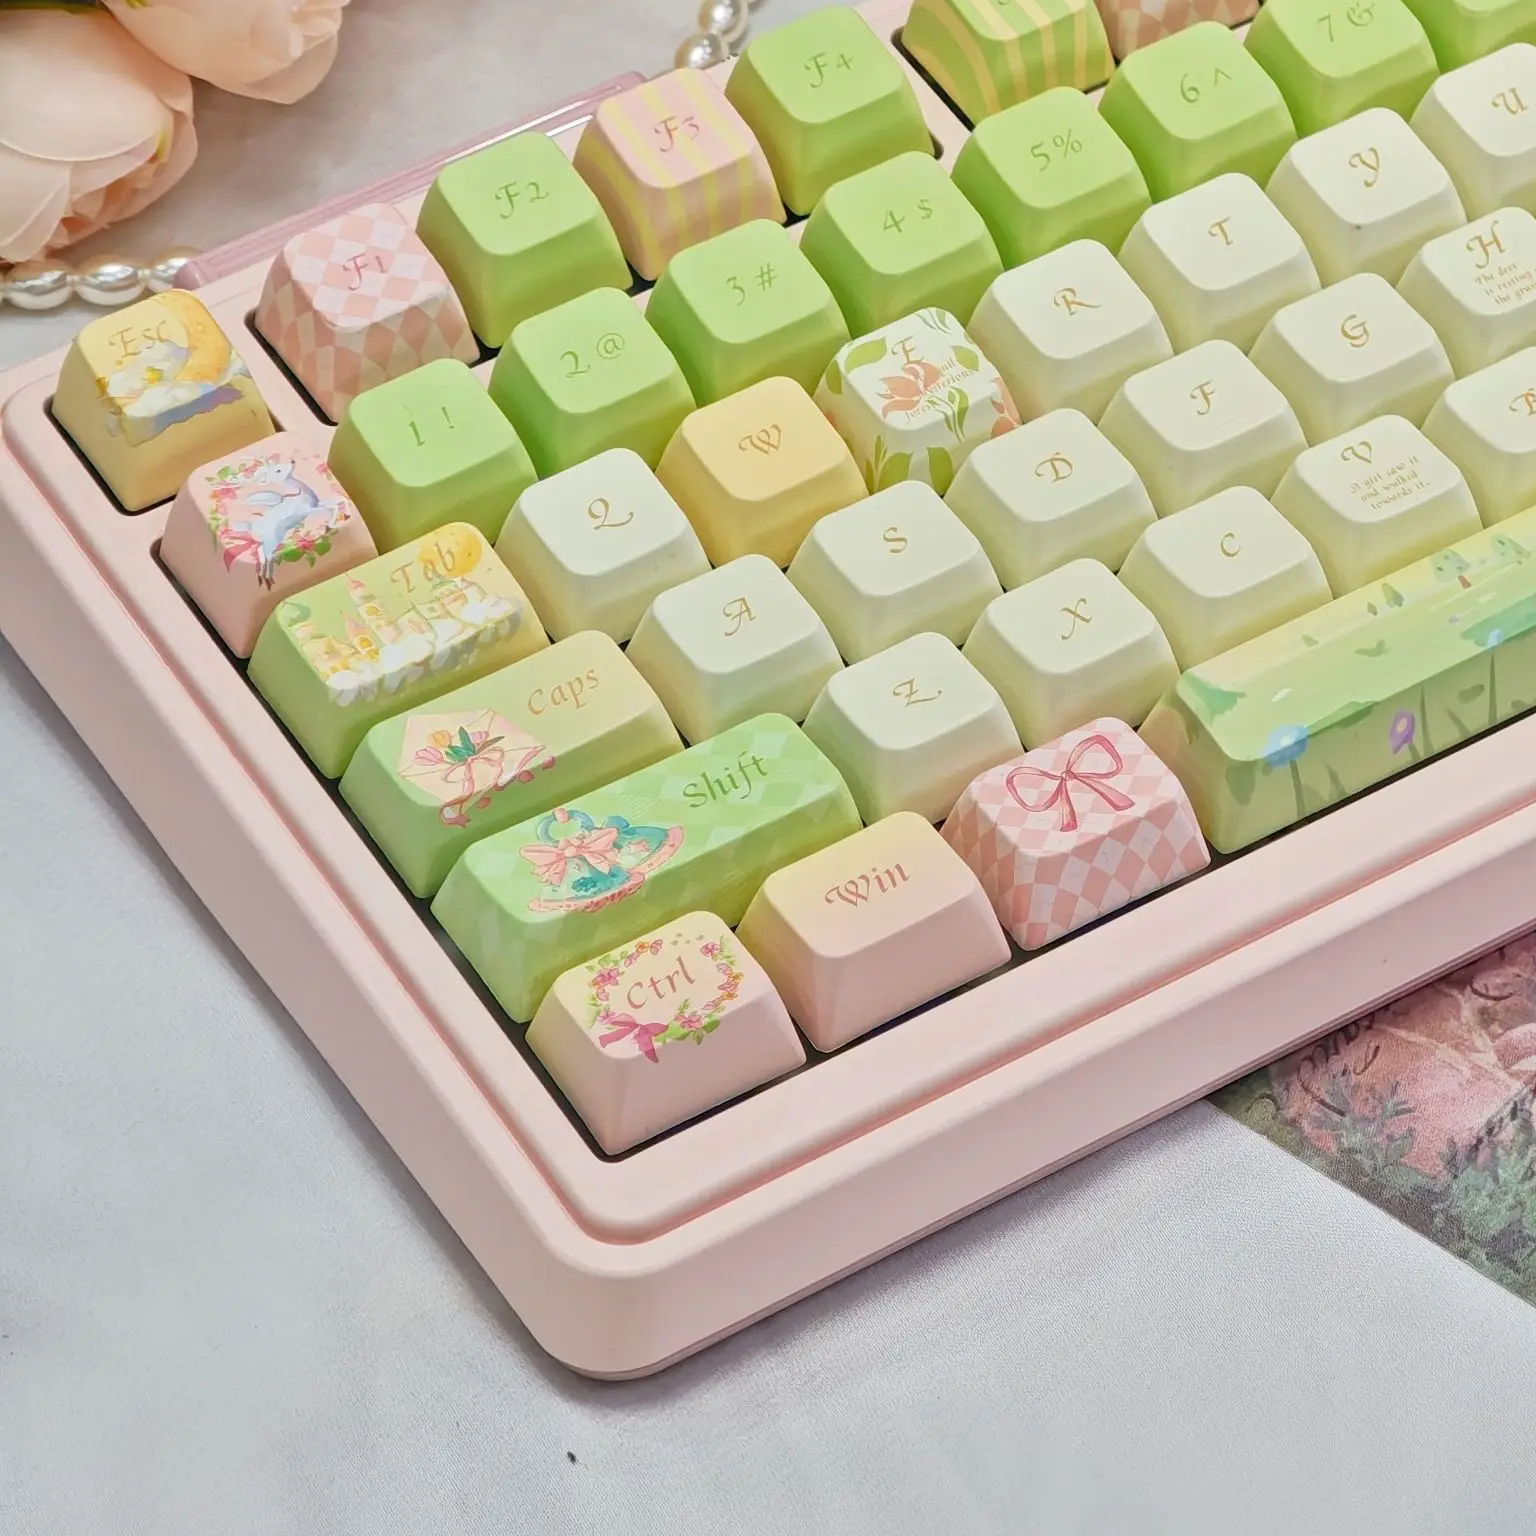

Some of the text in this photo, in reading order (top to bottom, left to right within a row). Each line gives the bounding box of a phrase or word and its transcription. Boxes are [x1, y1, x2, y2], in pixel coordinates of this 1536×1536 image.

[803, 52, 853, 89] F4
[1490, 86, 1529, 116] U
[654, 115, 701, 152] F3
[494, 180, 550, 220] F2
[1464, 218, 1508, 271] H
[343, 254, 386, 291] F1
[1053, 287, 1101, 317] R
[109, 320, 167, 360] Esc
[1340, 314, 1370, 349] G
[738, 423, 782, 456] W
[1340, 440, 1373, 465] V
[1034, 451, 1074, 483] D
[882, 526, 908, 554] S
[1219, 532, 1241, 558] C
[389, 542, 455, 595] Tab
[722, 596, 757, 637] A
[1060, 597, 1093, 641] X
[526, 667, 600, 716] Caps
[678, 746, 769, 809] Shift
[824, 859, 910, 909] Win
[625, 956, 697, 1012] Ctrl
